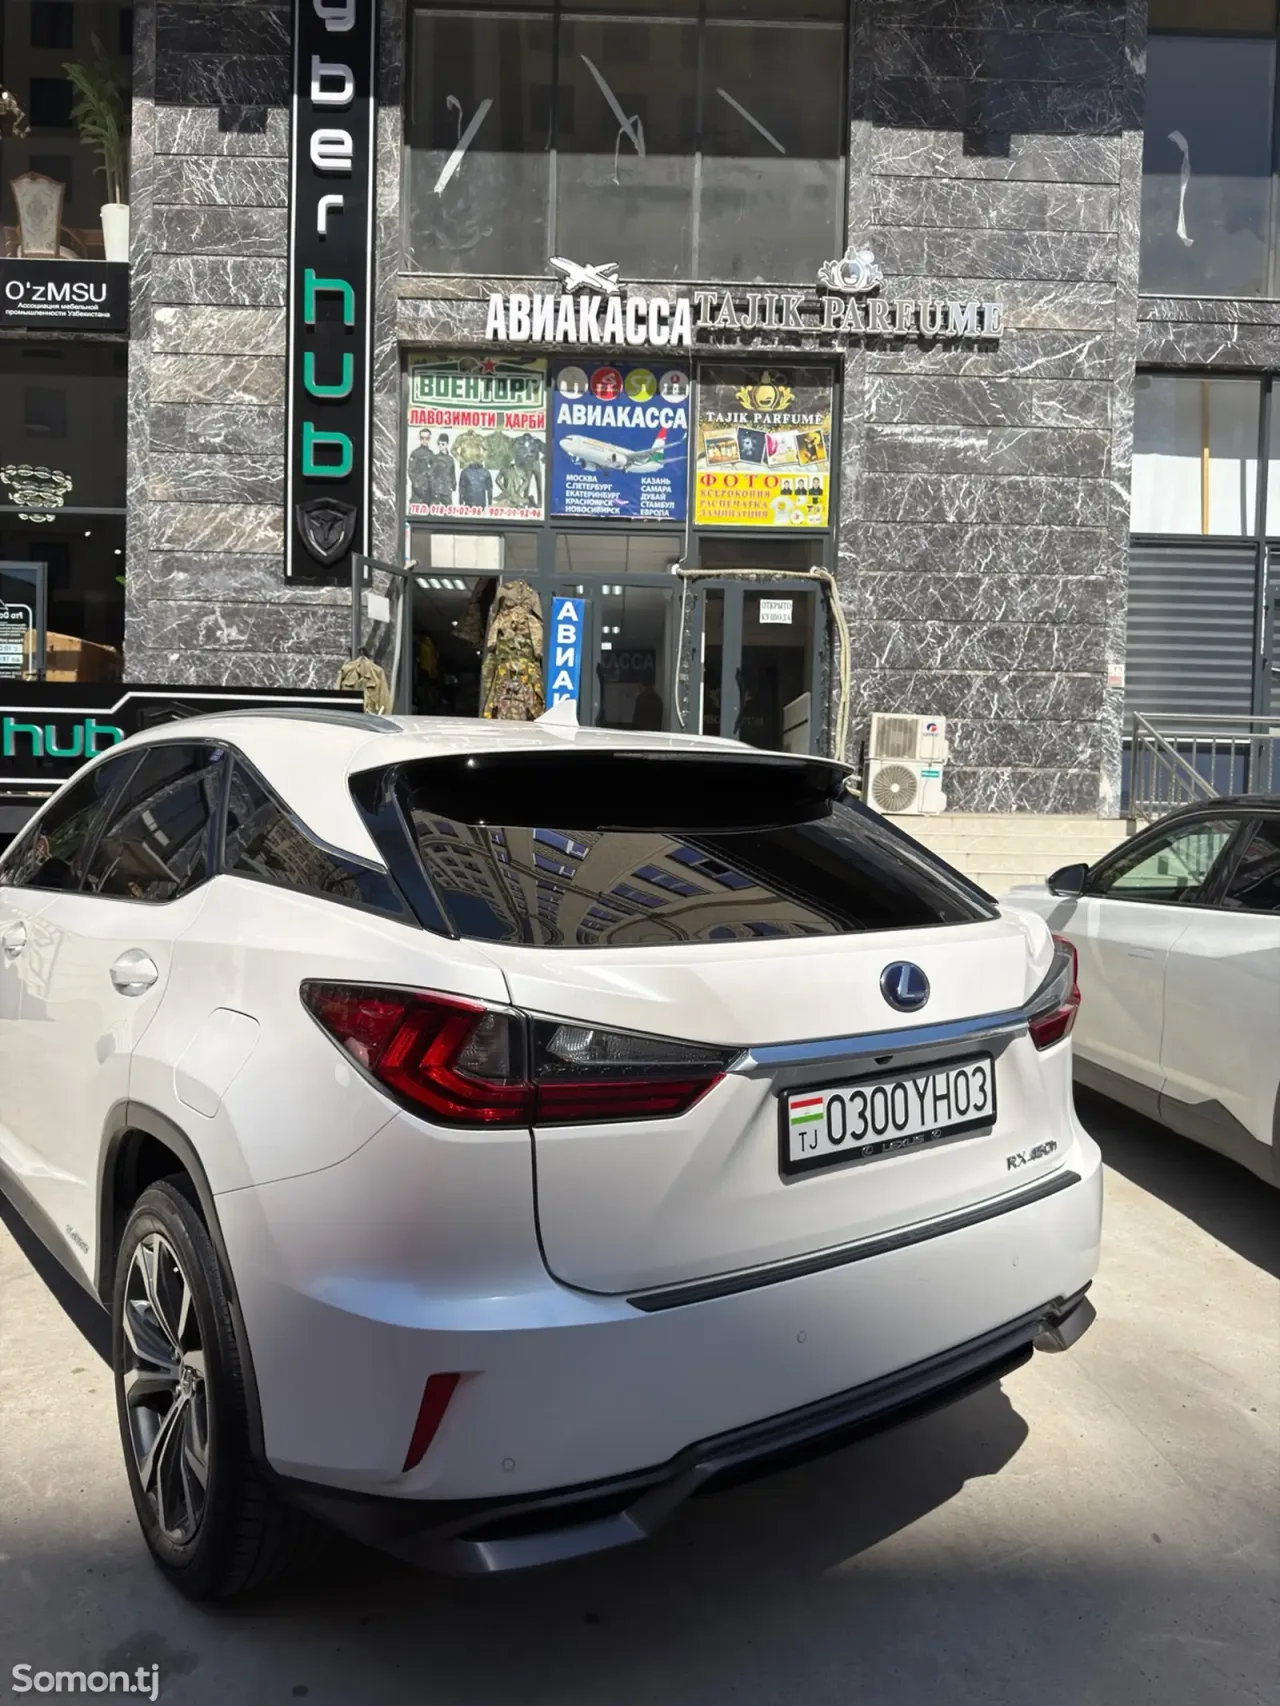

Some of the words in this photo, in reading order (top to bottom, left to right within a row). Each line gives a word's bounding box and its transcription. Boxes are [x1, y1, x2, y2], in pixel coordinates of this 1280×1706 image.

[5, 280, 107, 302] O'zMSU
[485, 293, 692, 346] АВИАКАССА
[695, 291, 806, 331] TAJIK
[823, 296, 1005, 338] PARFUME
[419, 375, 541, 402] ВОЕНТОРГ
[410, 409, 496, 427] ЛАВОЗИМОТИ
[557, 403, 687, 429] АВИАКАССА
[706, 411, 748, 423] TAJIK
[753, 413, 823, 425] PARFUME
[566, 474, 598, 483] МОСКВА
[641, 477, 671, 485] КАЗАНЬ
[700, 473, 779, 488] ФОТО
[566, 490, 620, 499] ЕКАТЕРИНБУРГ
[641, 485, 672, 493] САМАРА
[566, 498, 613, 507] КРАСНОЯРСК
[641, 500, 675, 509] СТАМБУЛ
[640, 508, 670, 517] ЕВРОПА
[3, 717, 125, 759] hub
[826, 1066, 987, 1145] 0300YH03
[798, 1129, 818, 1152] TJ
